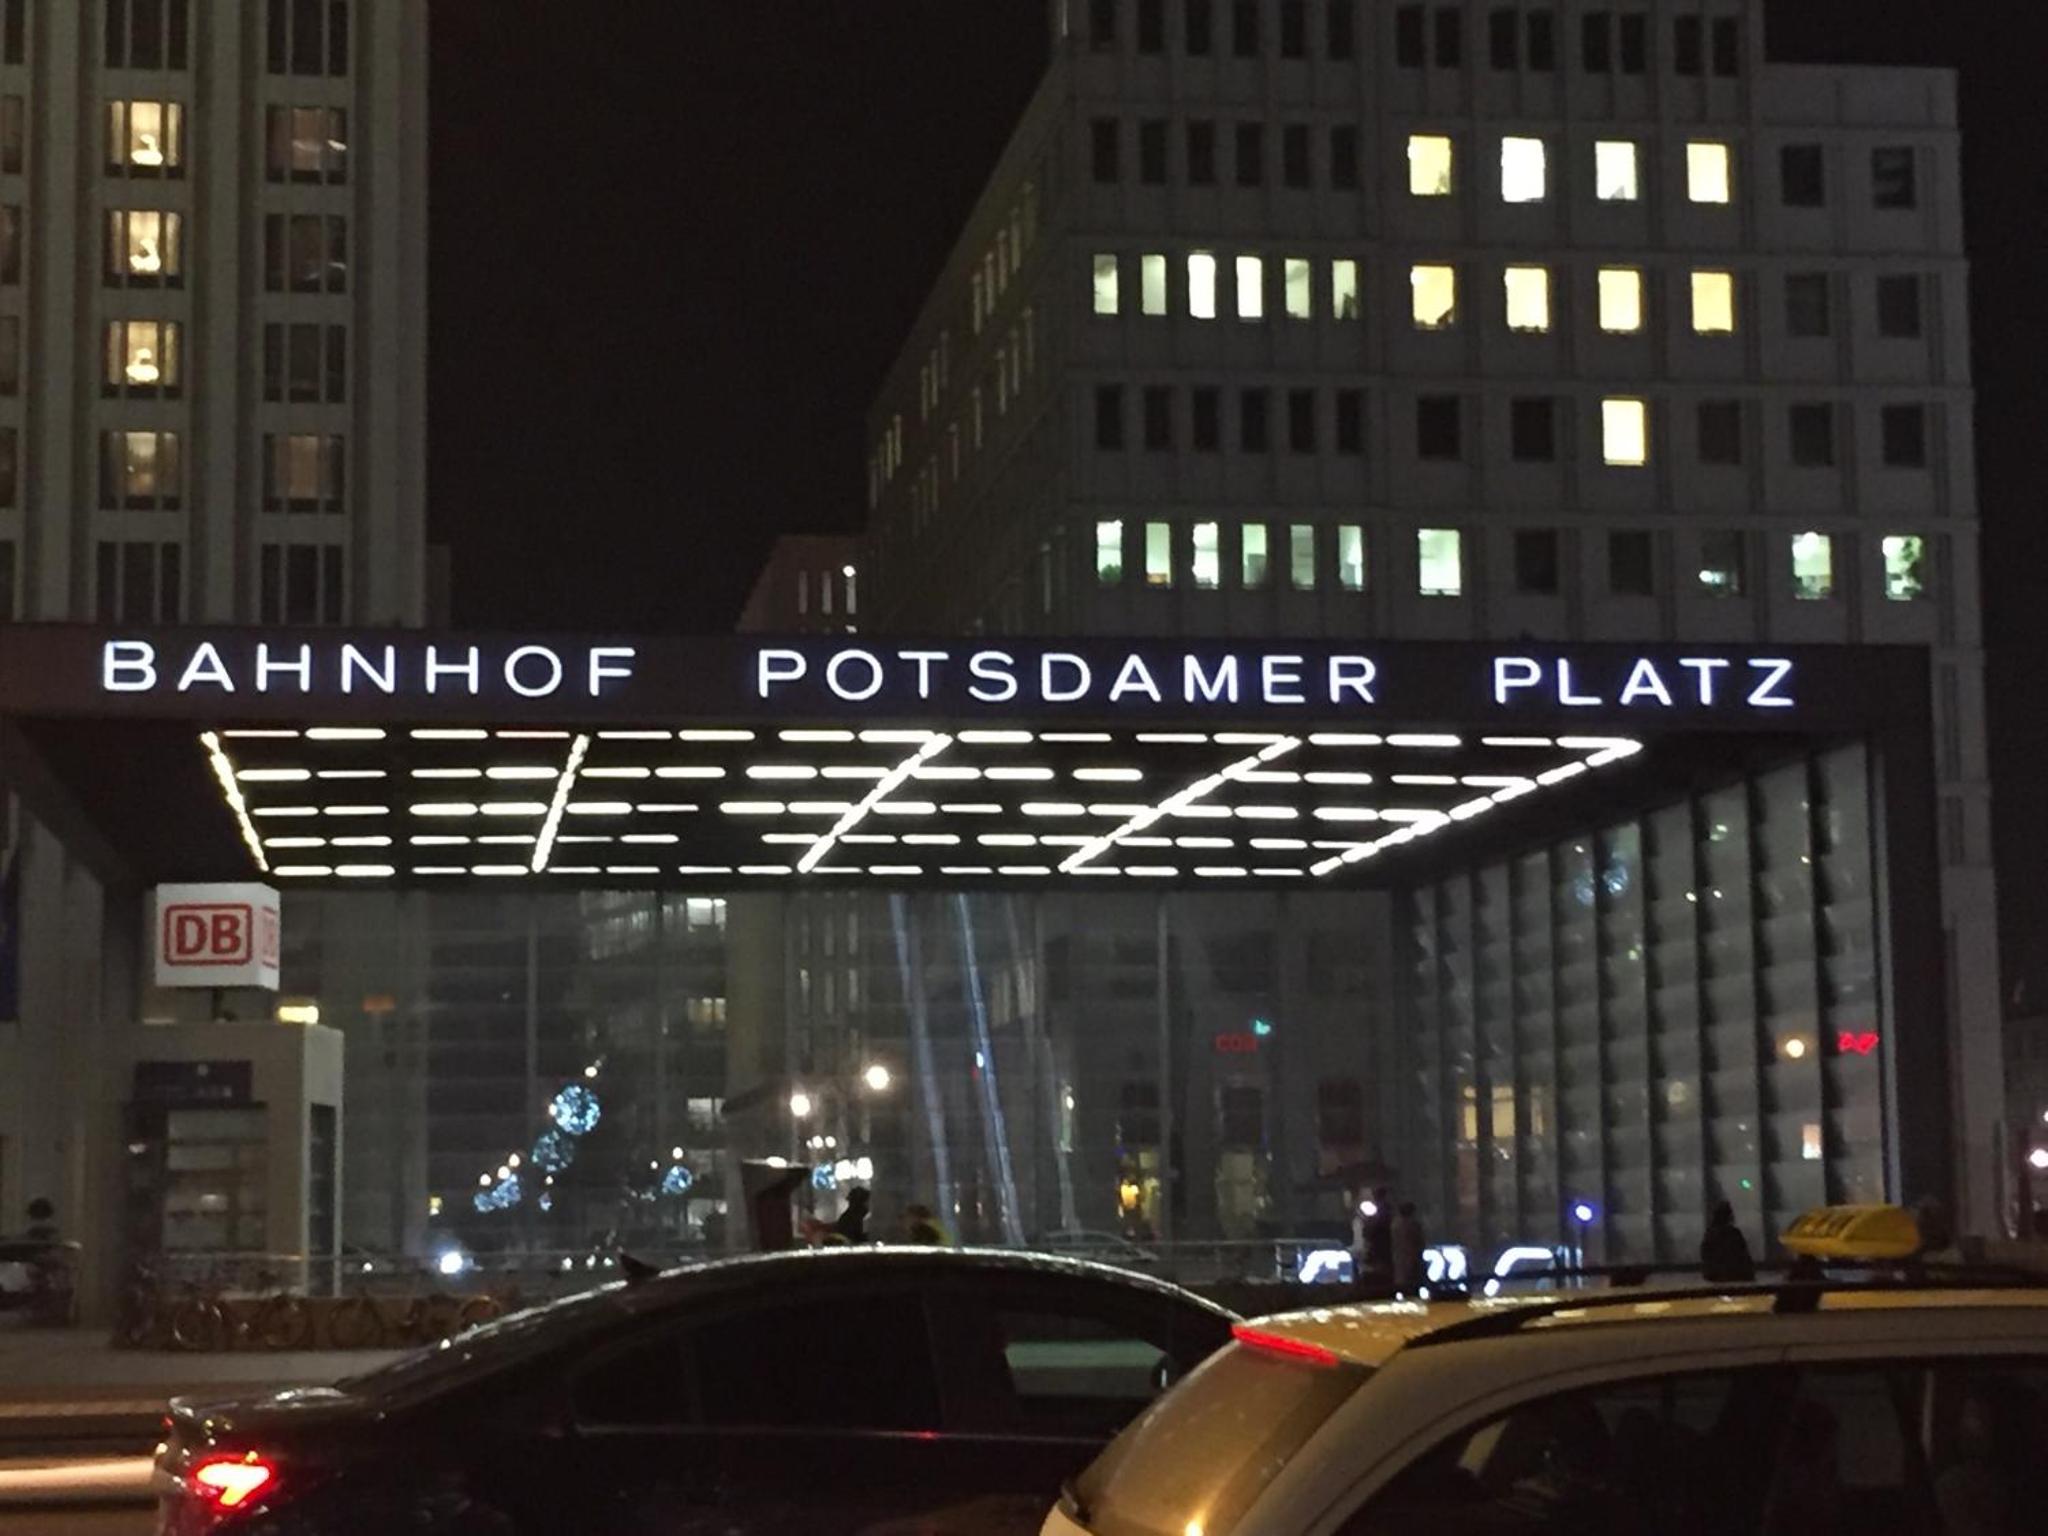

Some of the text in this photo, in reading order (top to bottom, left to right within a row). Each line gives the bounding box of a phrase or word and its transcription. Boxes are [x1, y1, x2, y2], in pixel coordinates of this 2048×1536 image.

[102, 640, 1795, 707] BAHNHOF POTSDAMER PLATZ
[174, 912, 242, 955] DB
